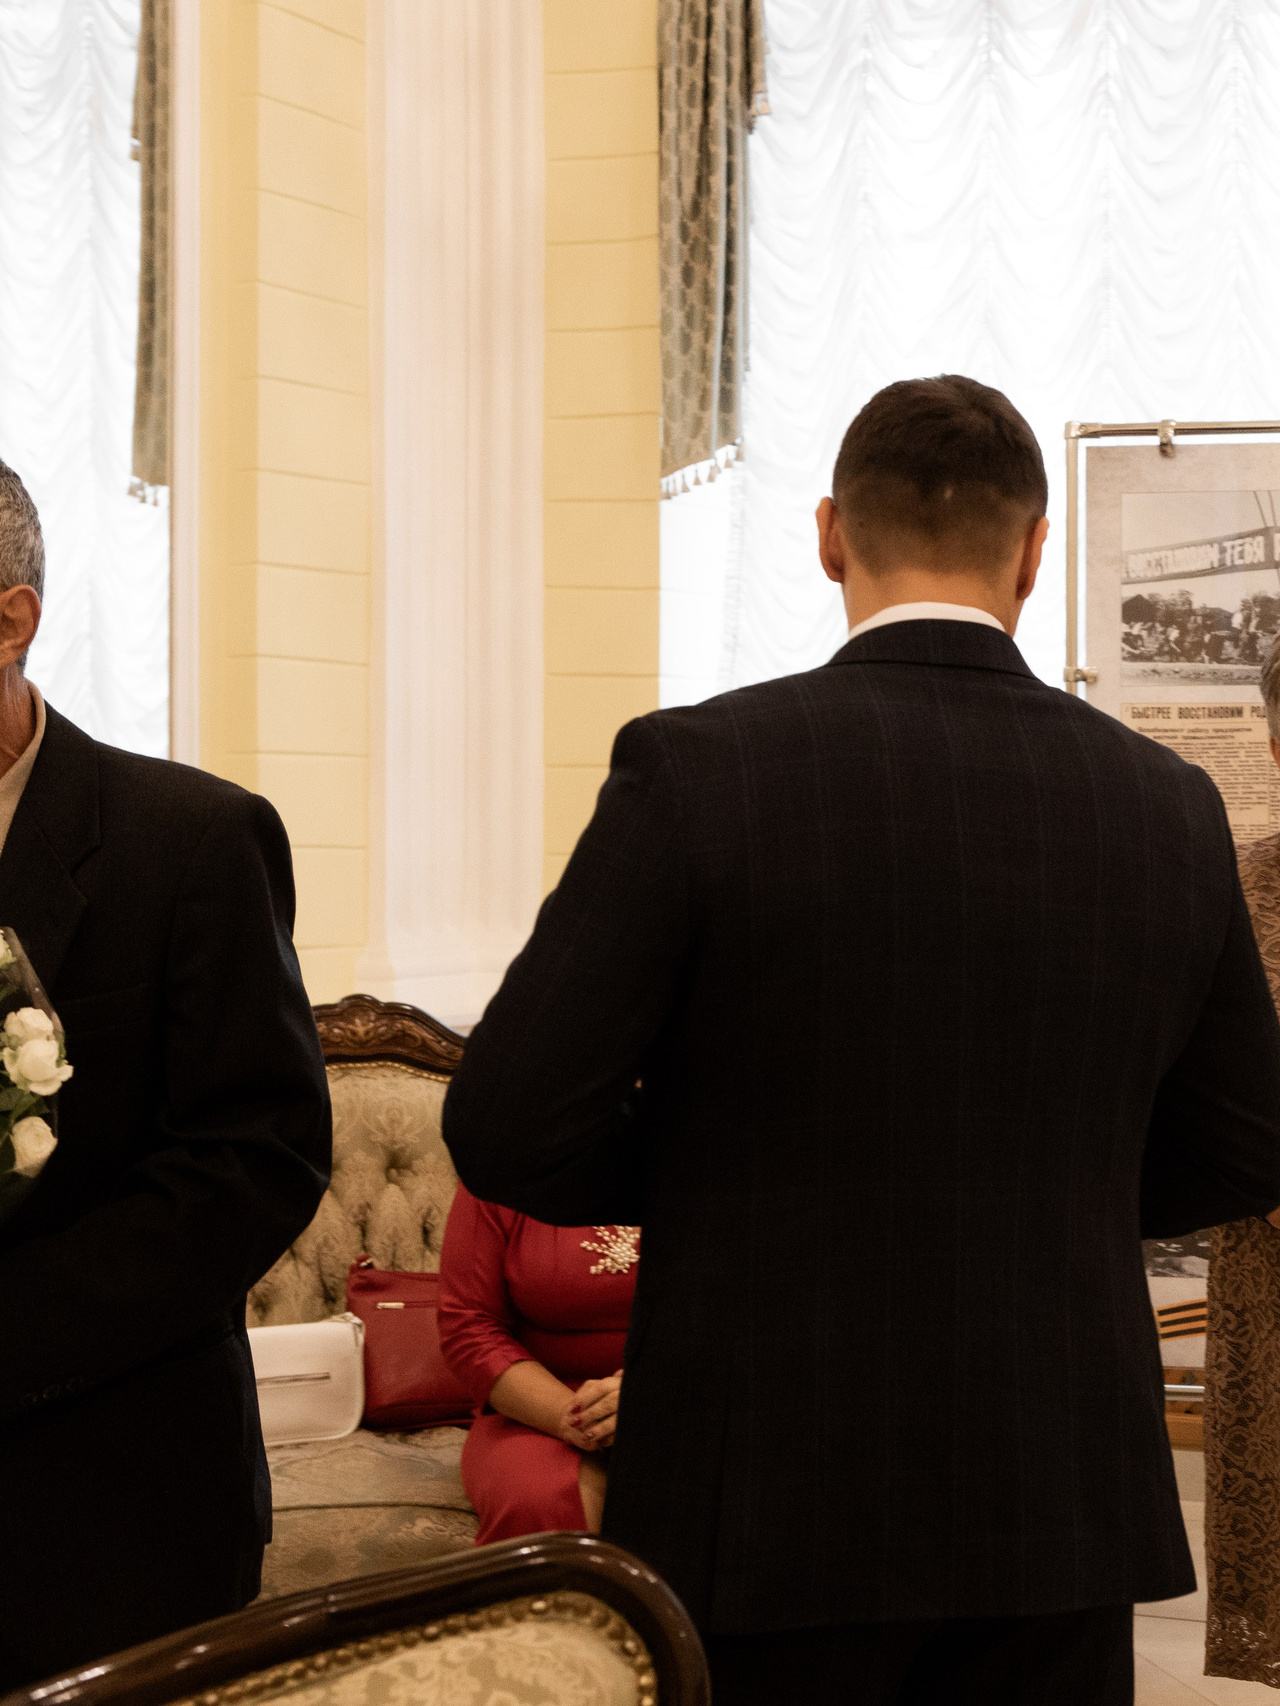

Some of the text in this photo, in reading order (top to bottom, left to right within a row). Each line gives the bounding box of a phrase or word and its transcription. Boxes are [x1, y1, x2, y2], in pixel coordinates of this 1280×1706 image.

[1223, 535, 1265, 566] ТЕБЯ
[1131, 706, 1171, 719] БЫСТРЕЕ
[1178, 706, 1243, 719] ВОССТАНОВИМ
